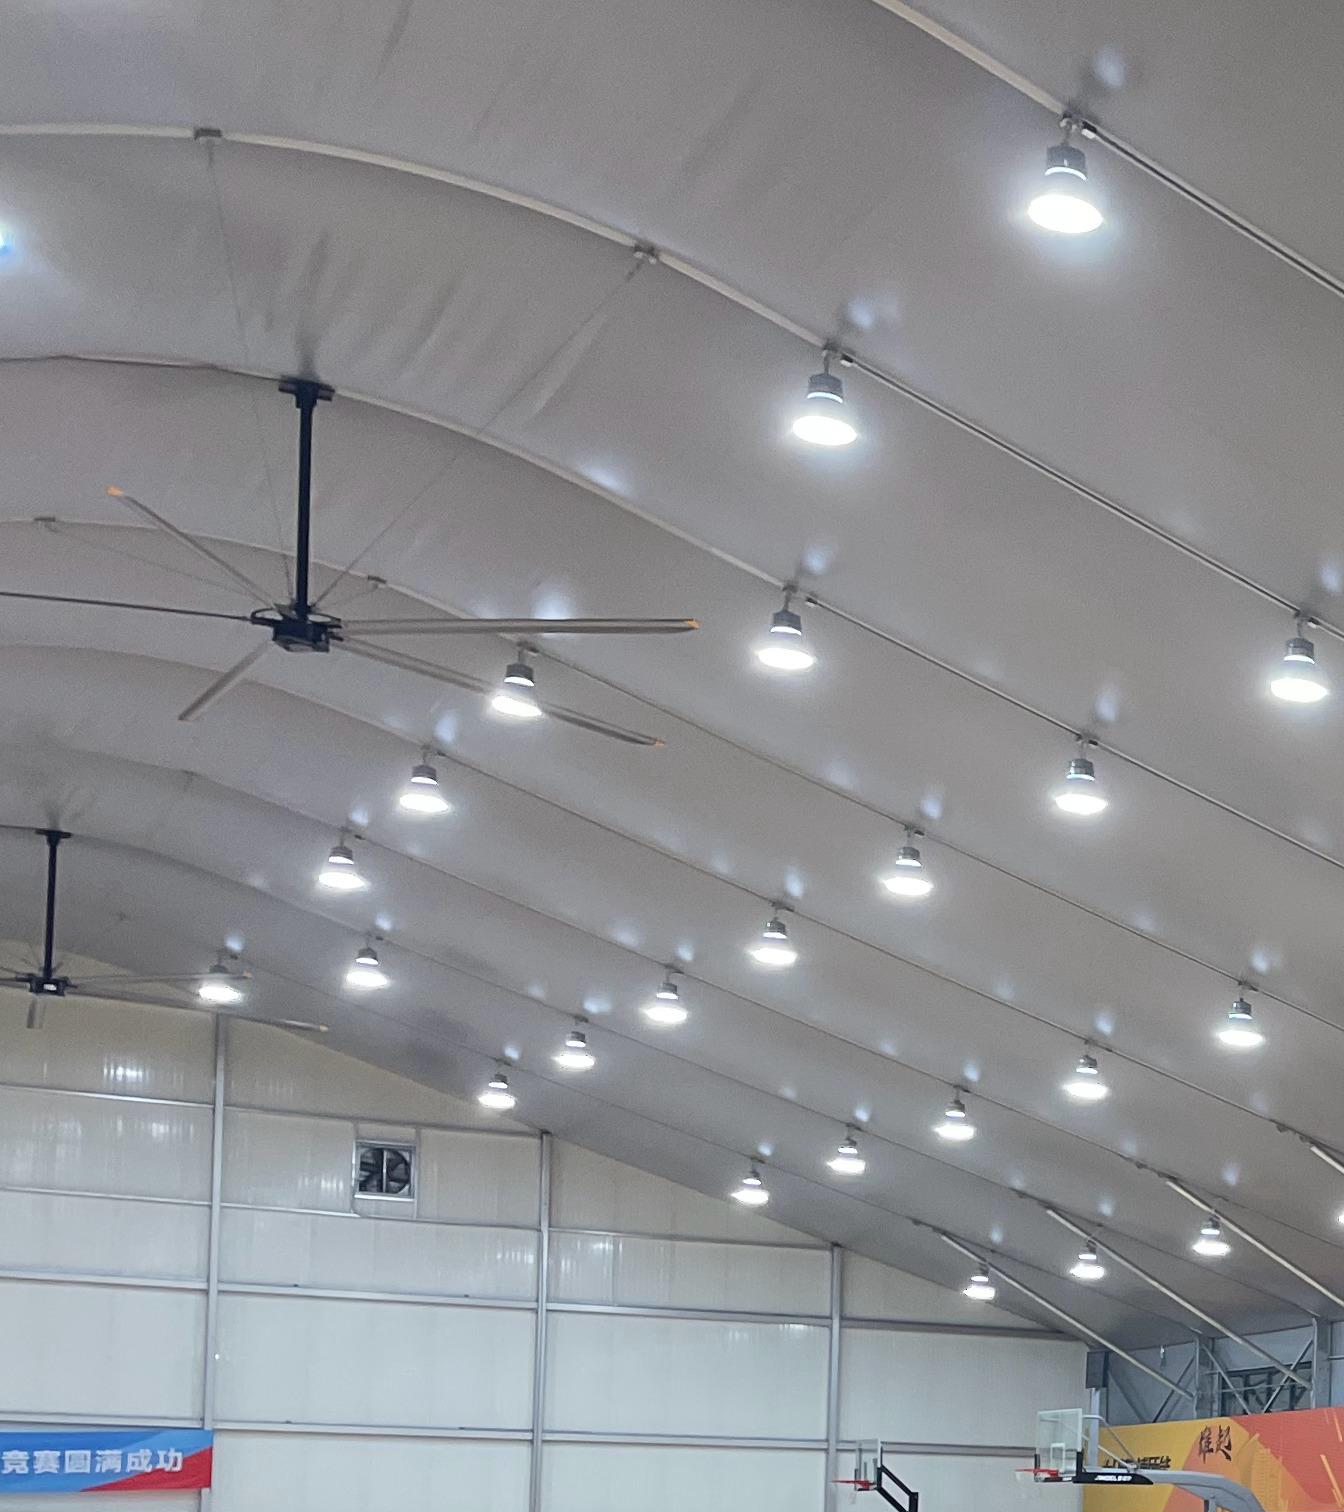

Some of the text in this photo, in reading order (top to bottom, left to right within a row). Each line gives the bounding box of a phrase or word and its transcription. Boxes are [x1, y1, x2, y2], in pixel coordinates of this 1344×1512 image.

[2, 1448, 183, 1473] 竞赛圆满成功
